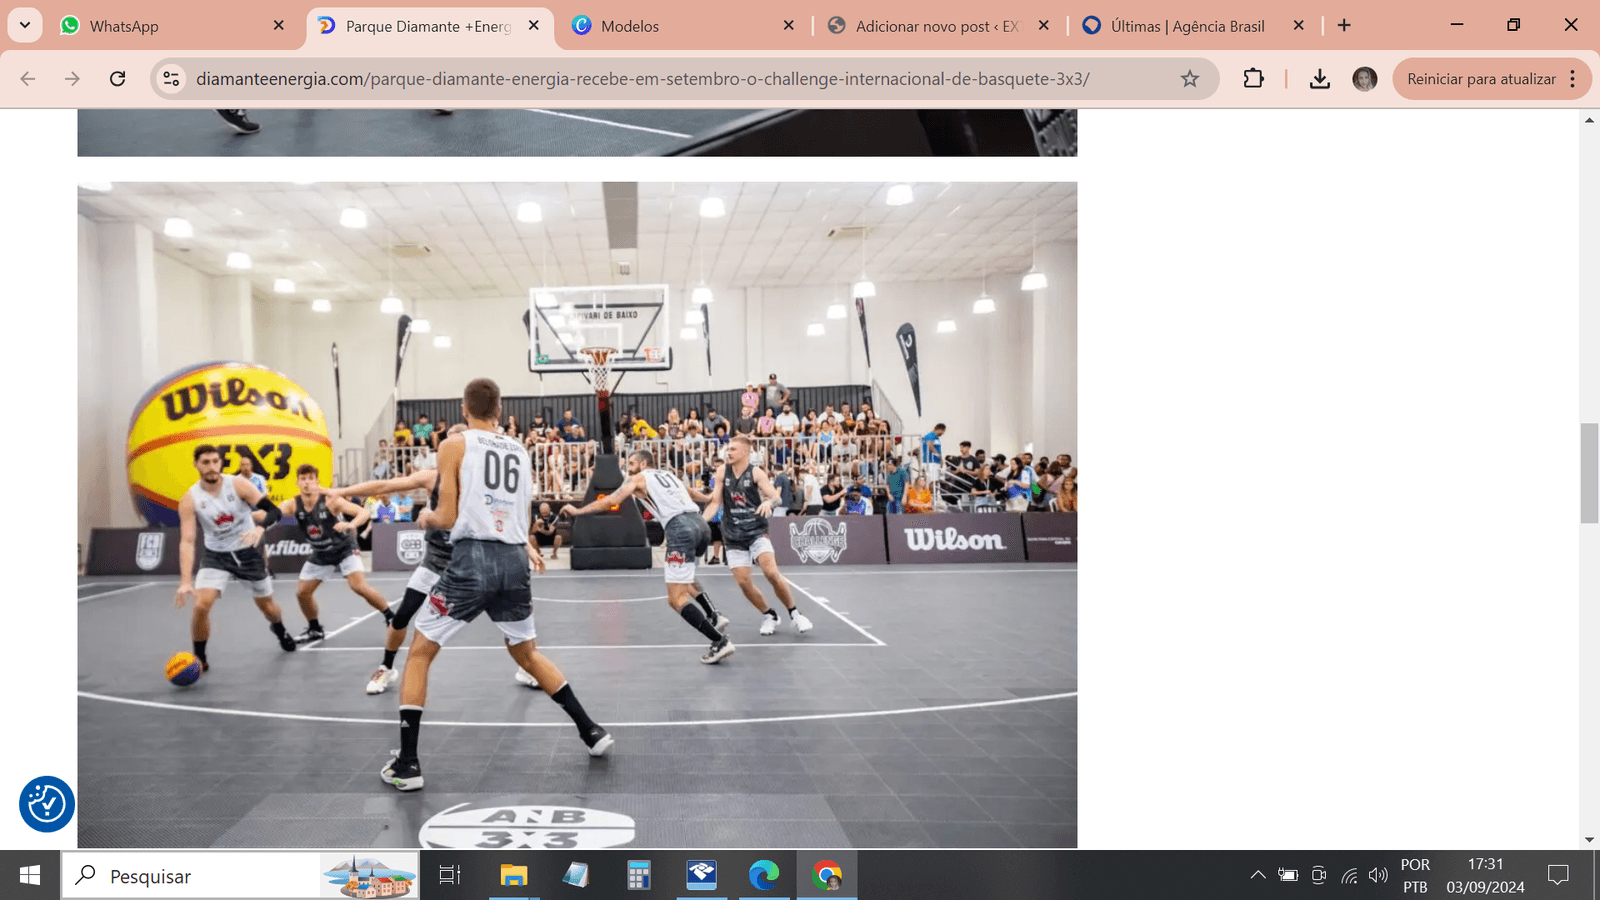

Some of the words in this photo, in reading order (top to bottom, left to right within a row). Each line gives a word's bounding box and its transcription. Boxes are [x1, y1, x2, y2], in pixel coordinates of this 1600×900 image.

[90, 19, 159, 35] WhatsApp
[346, 19, 393, 35] Parque
[396, 19, 460, 33] Diamante
[601, 19, 659, 33] Modelos
[856, 19, 920, 33] Adicionar
[923, 23, 957, 33] novo
[960, 20, 990, 36] post
[1111, 16, 1161, 33] Últimas
[1172, 19, 1226, 36] Agência
[1230, 19, 1265, 33] Brasil
[196, 70, 1091, 89] diamanteenergia.com/parque-diamante-energia-recebe-em-setembro-o-challenge-internacional-de-basquete-3x3/
[1408, 72, 1464, 86] Reiniciar
[1467, 75, 1497, 89] para
[1500, 71, 1557, 86] atualizar
[603, 310, 613, 320] DE
[616, 310, 638, 319] BAIXO
[160, 378, 313, 423] Wilson
[485, 450, 521, 494] 06
[793, 535, 845, 549] CHALLENGE
[481, 809, 586, 824] ANB
[1401, 858, 1431, 871] POR
[1468, 857, 1503, 871] 17:31
[110, 867, 192, 889] Pesquisar
[1403, 881, 1428, 894] PTB
[1446, 880, 1526, 895] 03/09/2024
